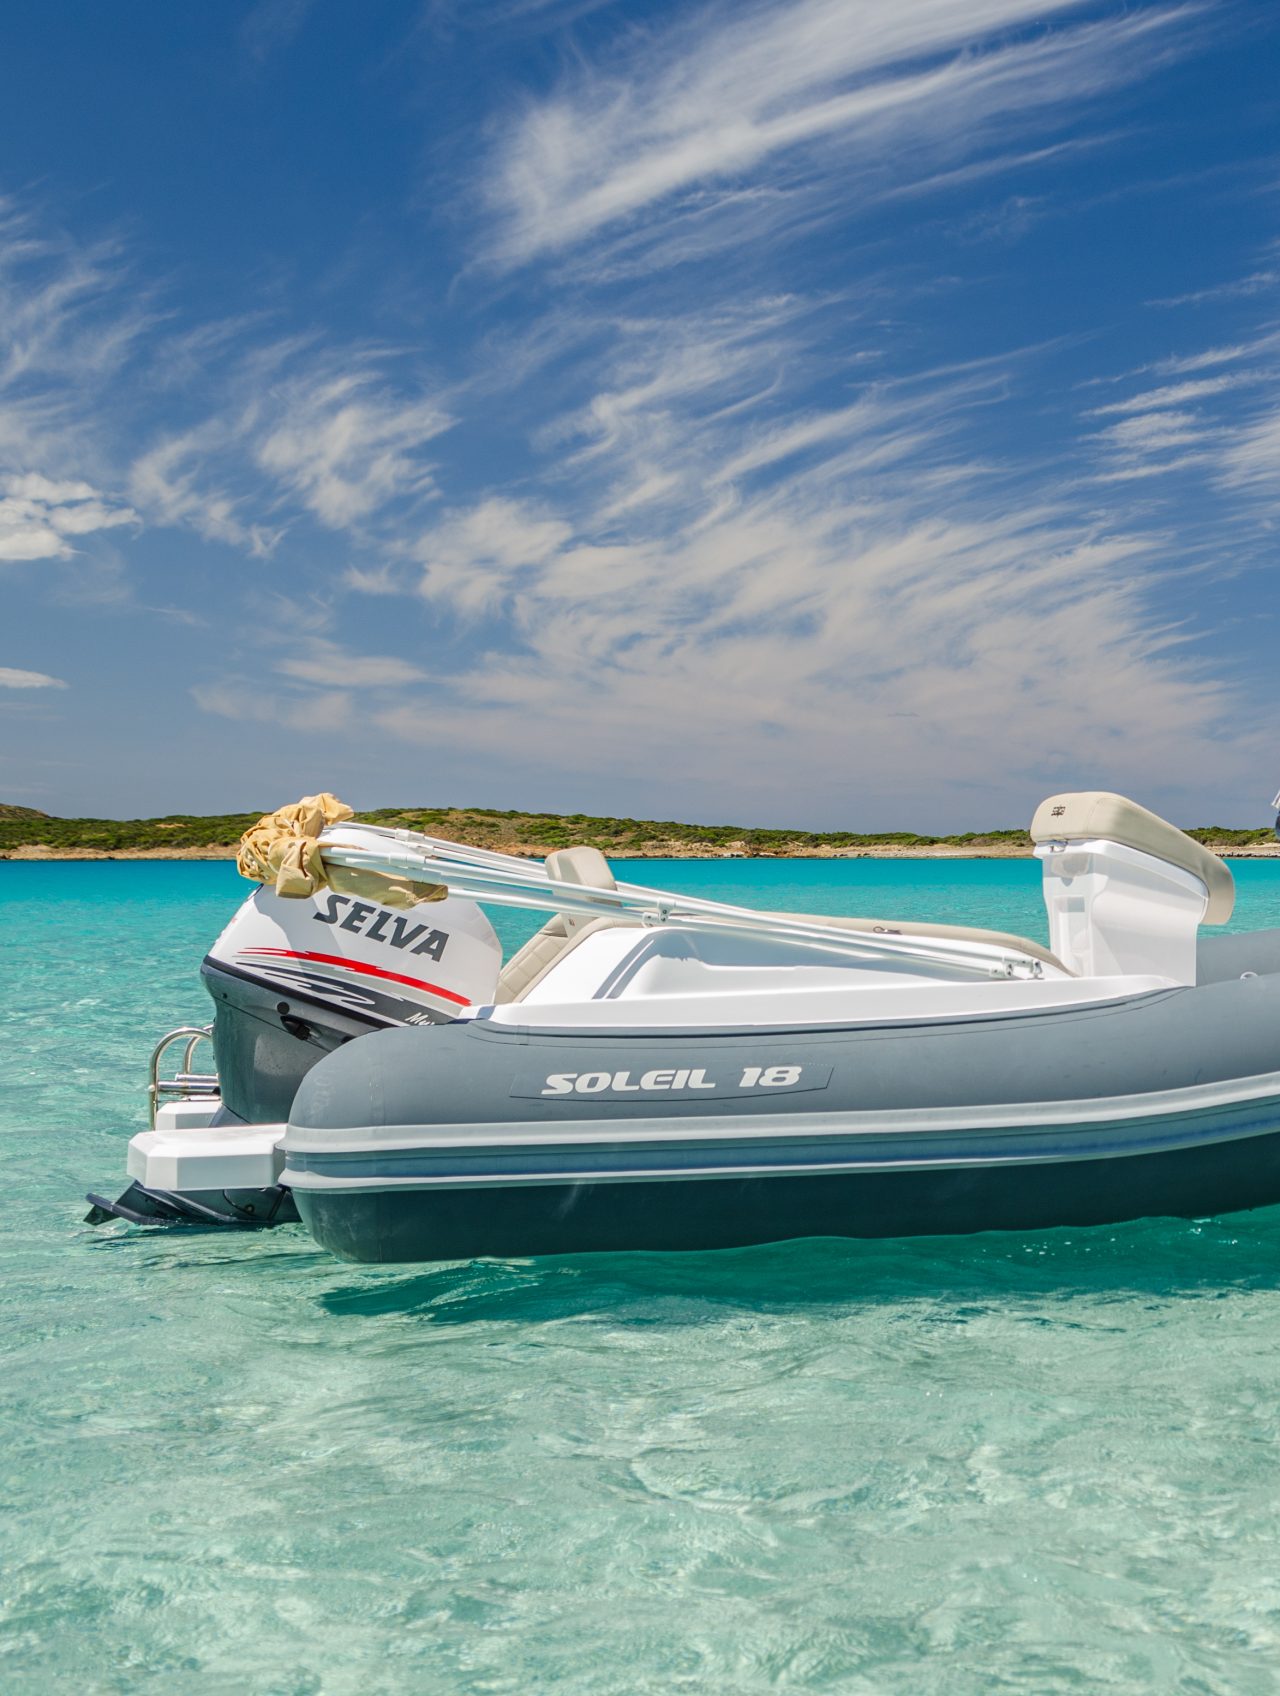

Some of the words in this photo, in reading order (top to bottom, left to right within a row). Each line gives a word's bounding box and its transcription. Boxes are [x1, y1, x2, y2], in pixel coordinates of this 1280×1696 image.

[313, 894, 450, 963] SELVA
[541, 1068, 716, 1095] SOLEIL
[738, 1066, 802, 1088] 18
